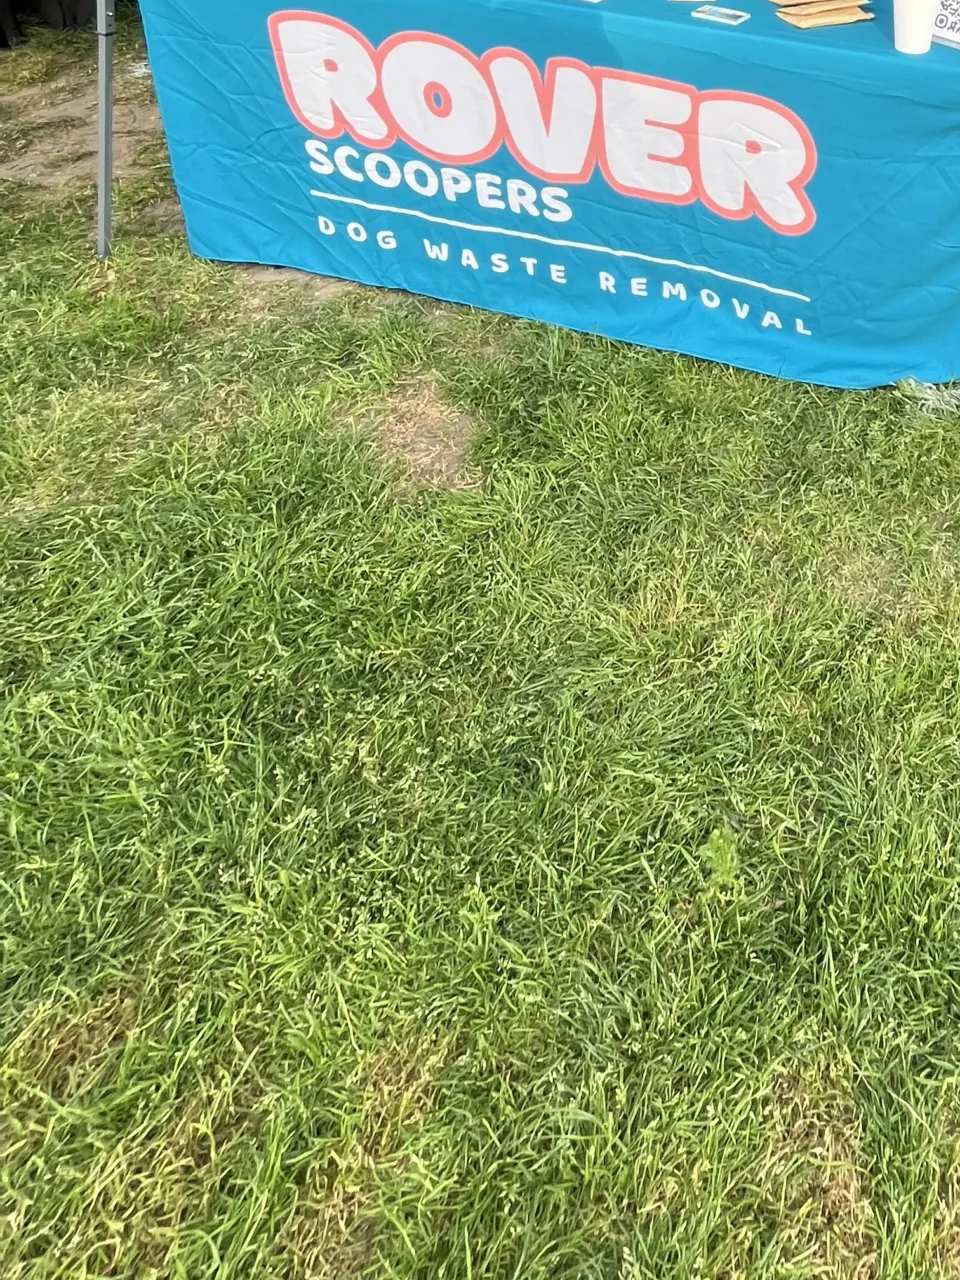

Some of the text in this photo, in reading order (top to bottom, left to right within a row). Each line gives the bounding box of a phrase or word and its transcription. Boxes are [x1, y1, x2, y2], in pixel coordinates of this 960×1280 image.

[268, 10, 816, 236] ROVER
[304, 140, 573, 222] SCOOPERS
[318, 216, 812, 336] DOG WASTE REMOVAL
